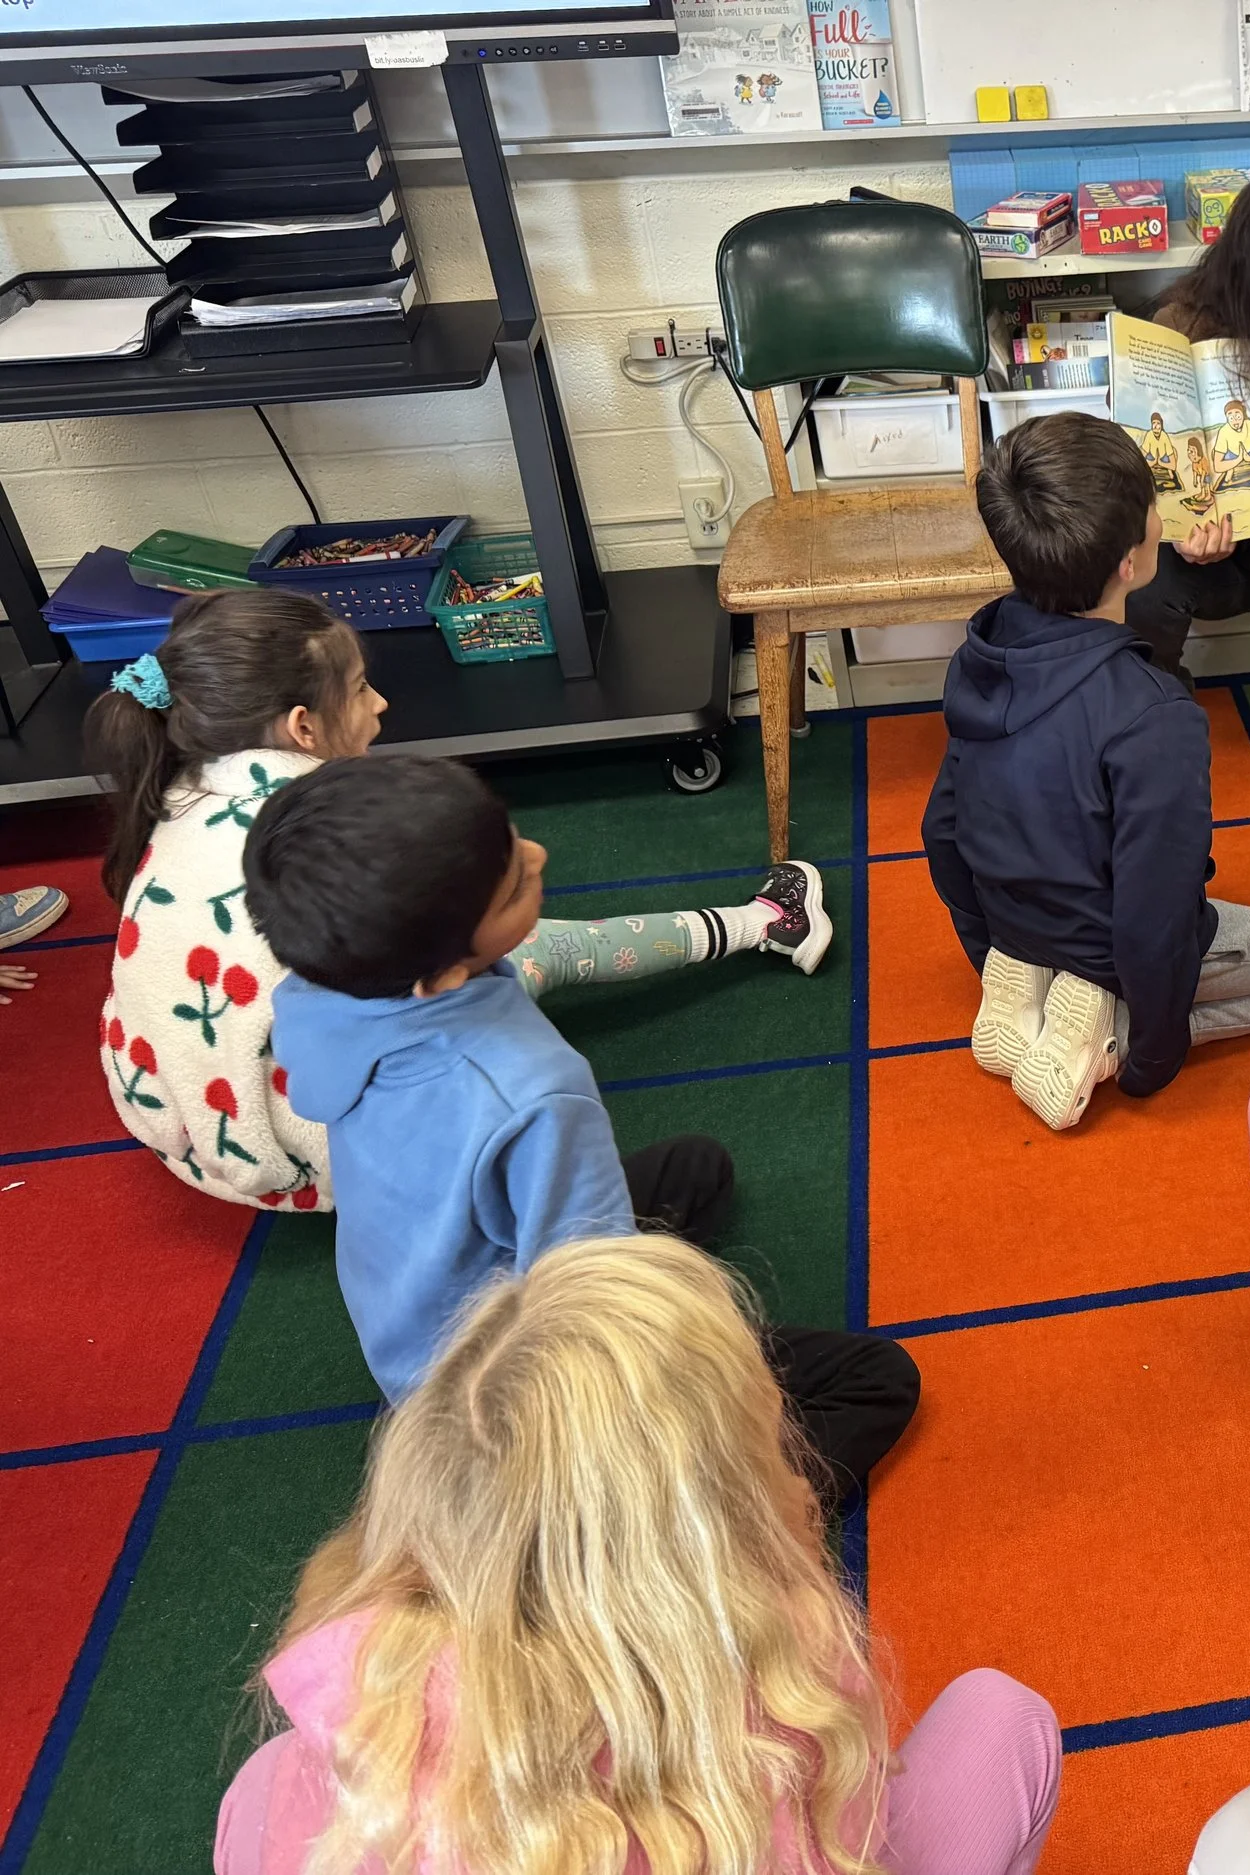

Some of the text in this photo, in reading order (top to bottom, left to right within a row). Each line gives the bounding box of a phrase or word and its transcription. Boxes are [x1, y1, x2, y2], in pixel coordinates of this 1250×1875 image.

[680, 10, 697, 18] STORY
[699, 9, 716, 18] ABOUT
[724, 8, 742, 16] SIMPLE
[743, 7, 754, 16] ACT
[755, 7, 762, 15] OF
[764, 6, 789, 15] KINDNESS
[810, 0, 833, 12] HOW
[810, 9, 868, 46] Full
[825, 48, 850, 58] YOUR
[815, 57, 889, 81] BUCKET?
[978, 234, 1010, 246] EARTH
